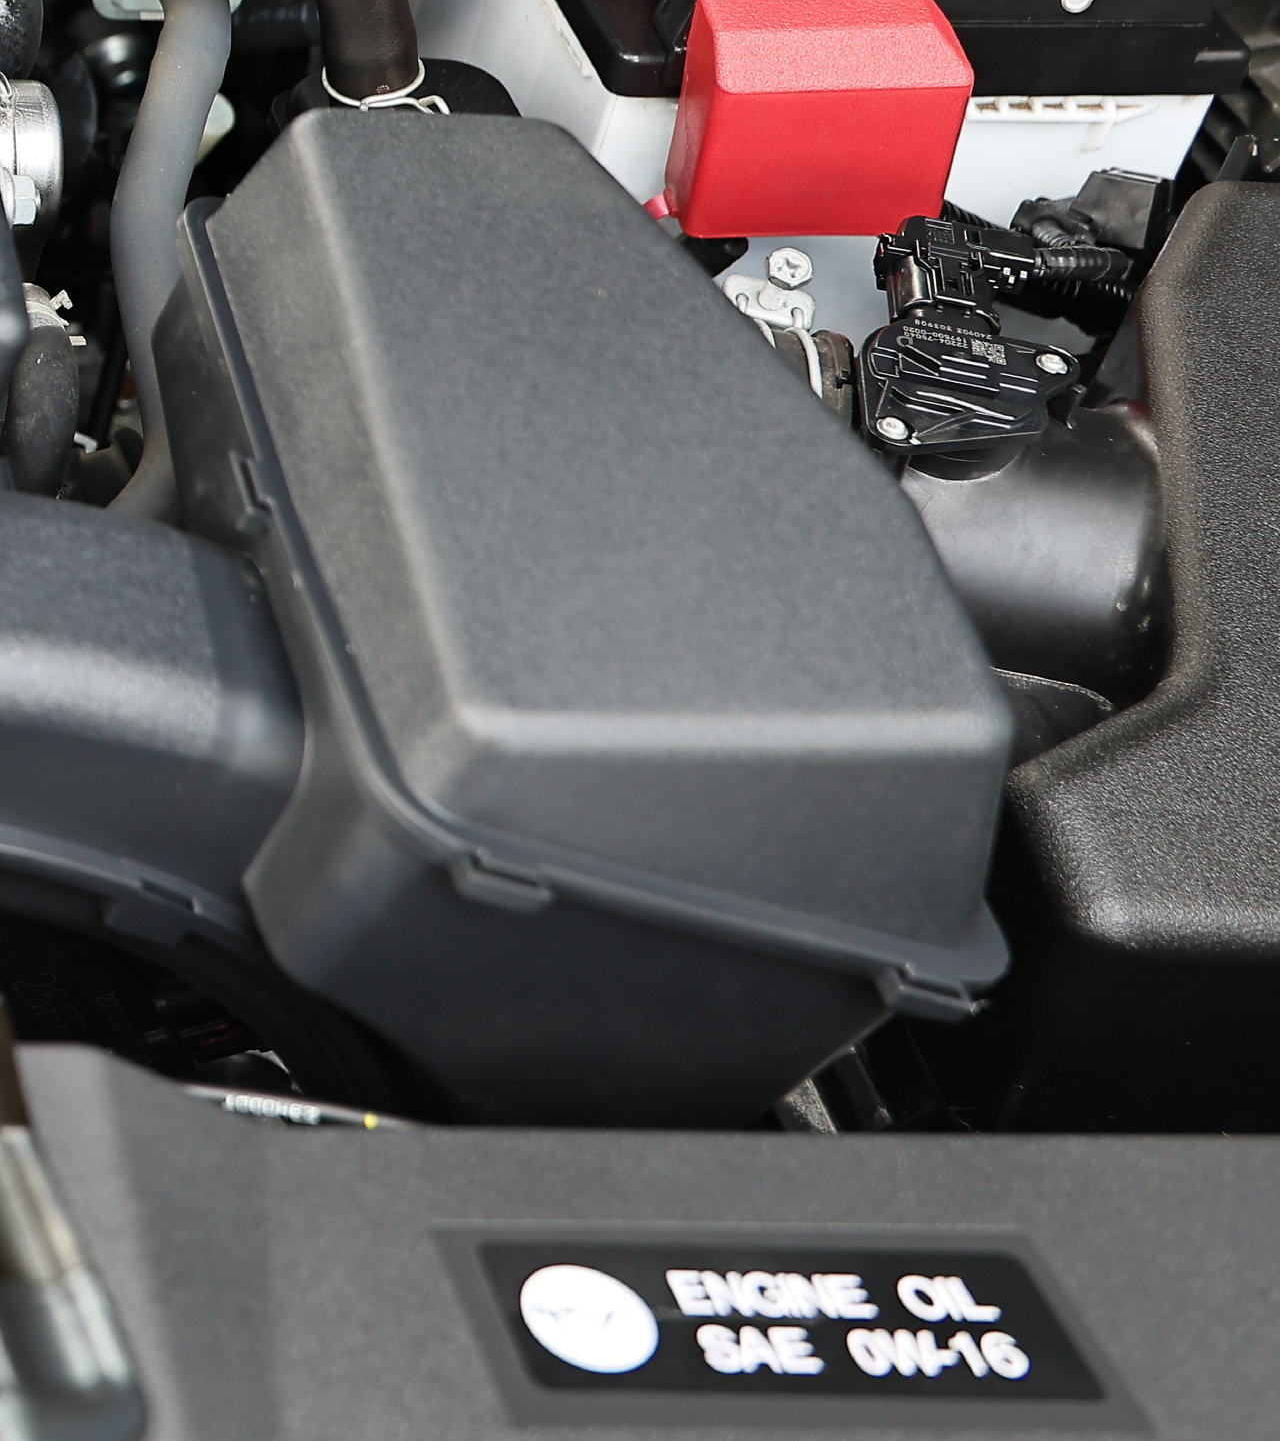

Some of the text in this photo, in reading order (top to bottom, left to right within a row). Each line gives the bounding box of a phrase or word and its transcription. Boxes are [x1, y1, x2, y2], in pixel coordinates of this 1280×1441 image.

[665, 1268, 1002, 1323] ENGINE OIL
[696, 1324, 1032, 1381] SAE 0W-16
